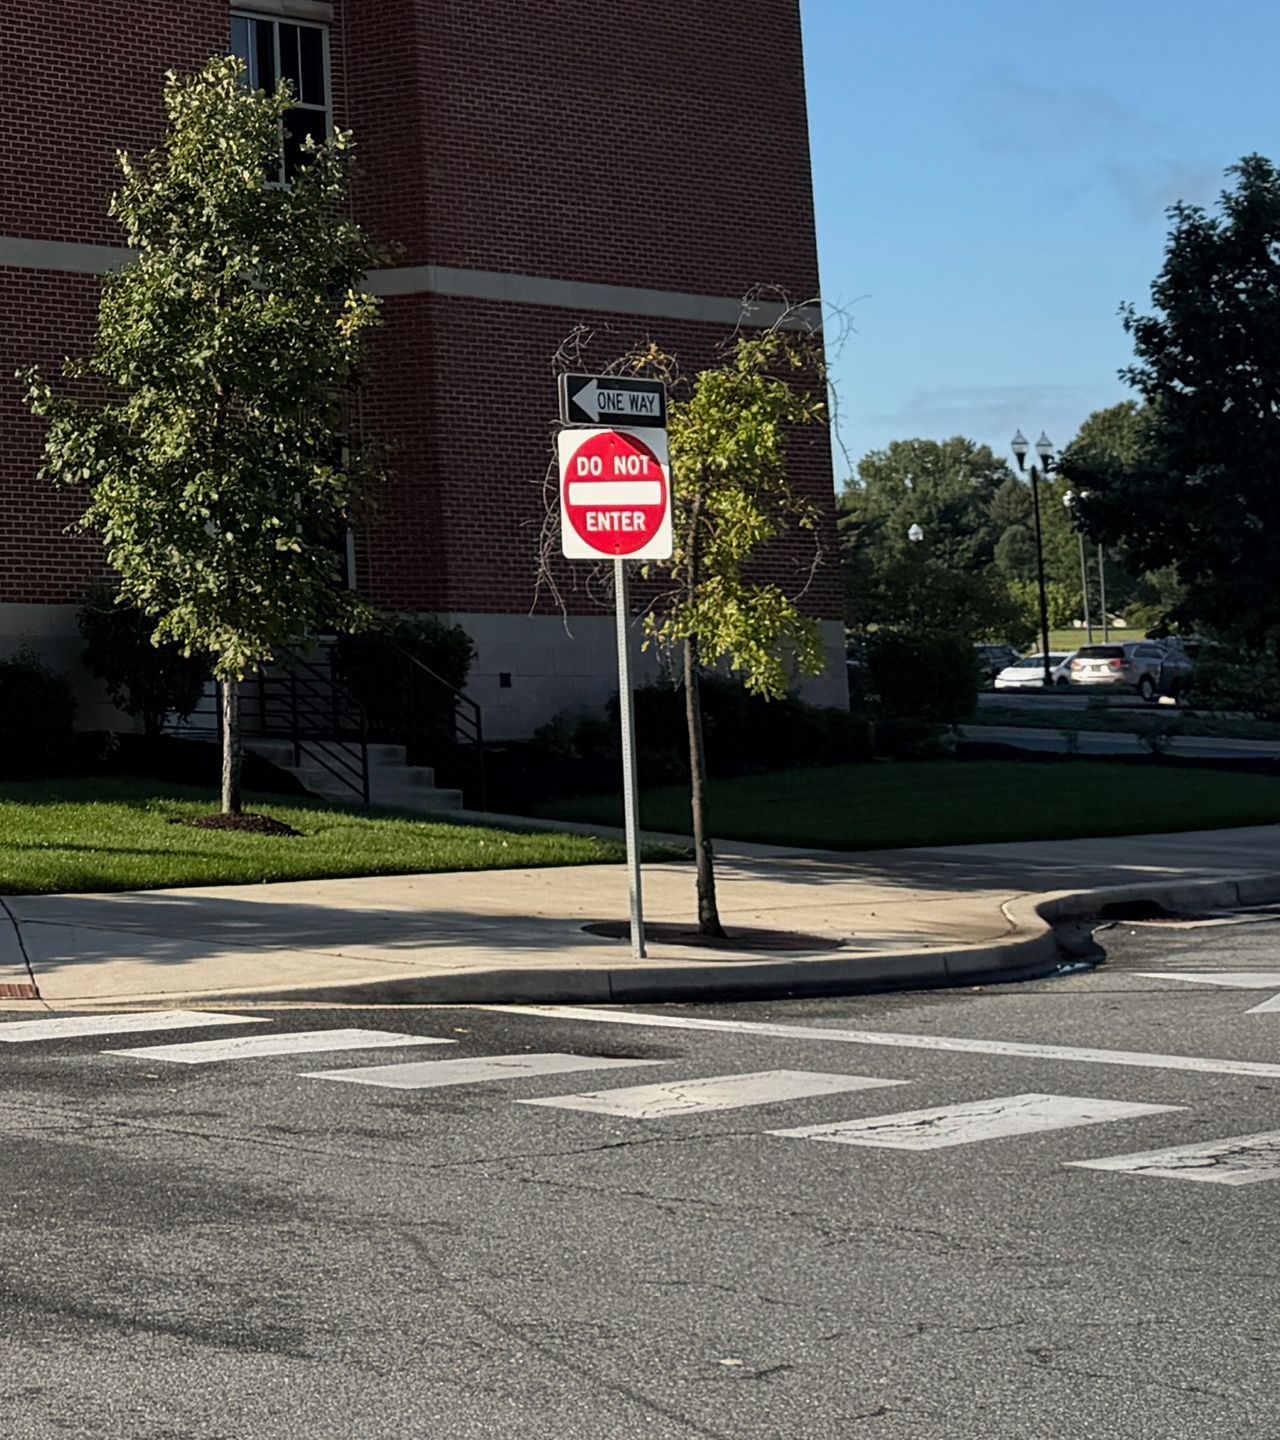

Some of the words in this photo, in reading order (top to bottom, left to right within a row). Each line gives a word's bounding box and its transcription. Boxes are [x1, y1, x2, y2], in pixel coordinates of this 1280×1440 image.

[597, 392, 625, 411] ONE
[629, 393, 656, 413] WAY
[576, 456, 603, 476] DO
[613, 455, 650, 475] NOT
[585, 511, 646, 531] ENTER
